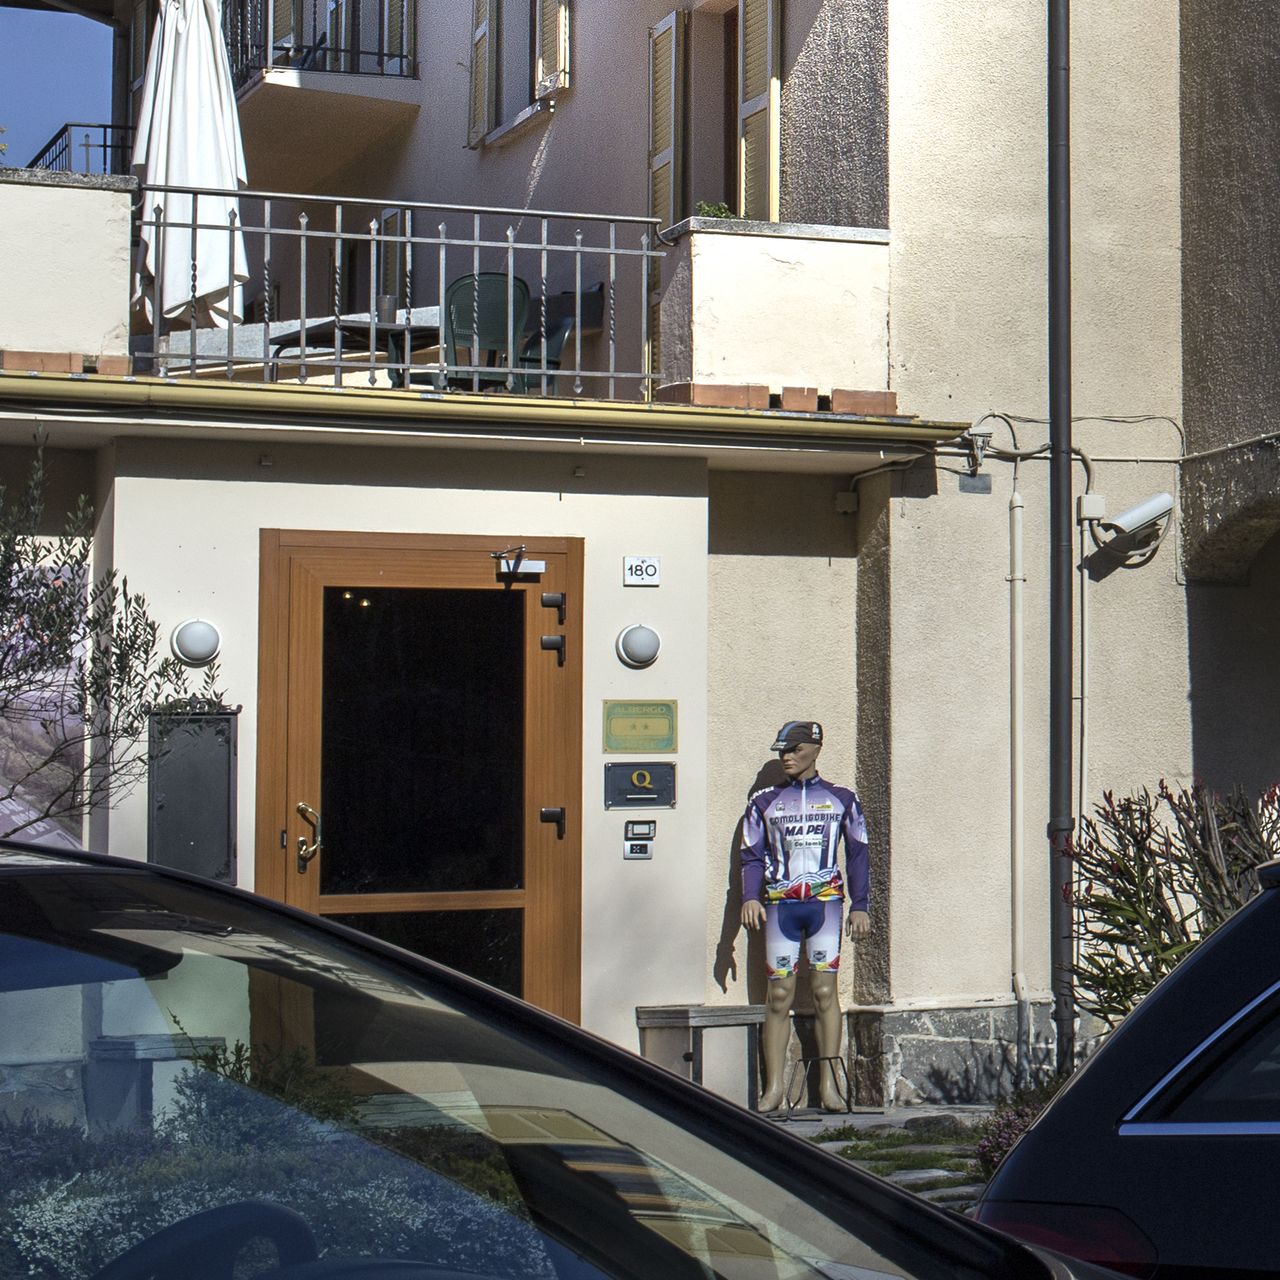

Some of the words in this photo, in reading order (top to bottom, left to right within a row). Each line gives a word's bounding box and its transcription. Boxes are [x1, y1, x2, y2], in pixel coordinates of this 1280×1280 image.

[627, 564, 657, 577] 180
[631, 769, 654, 789] Q
[784, 824, 826, 837] MAPEI
